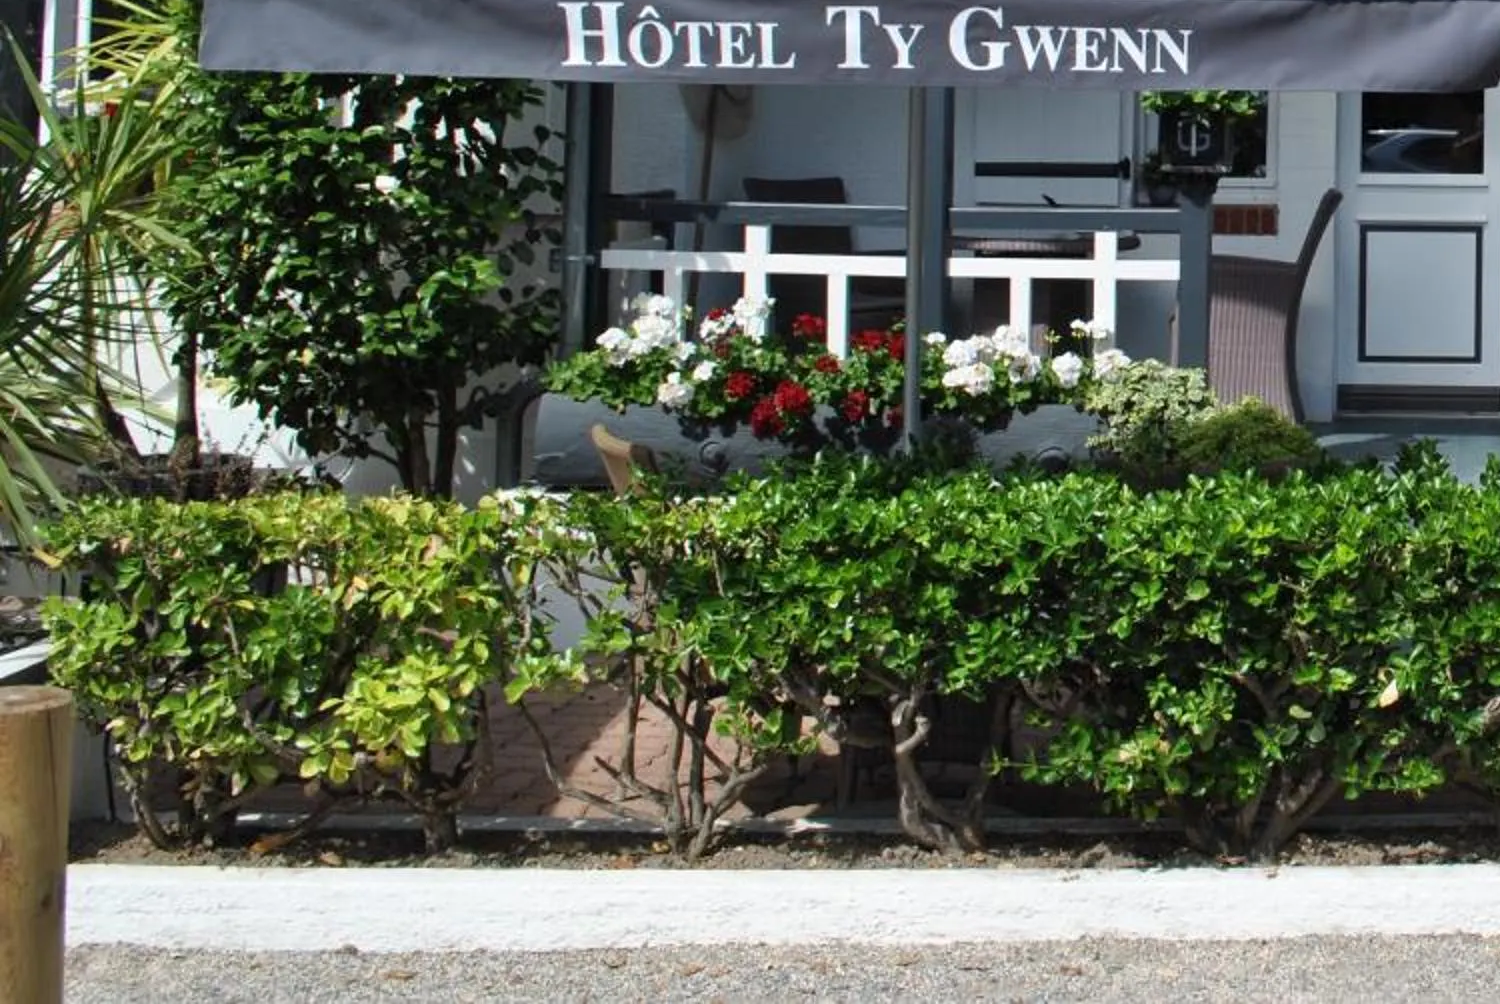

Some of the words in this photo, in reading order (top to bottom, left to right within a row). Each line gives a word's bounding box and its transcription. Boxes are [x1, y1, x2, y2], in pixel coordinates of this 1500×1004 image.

[557, 1, 796, 69] HÔTEL
[826, 6, 923, 69] TY
[949, 7, 1192, 74] GWENN
